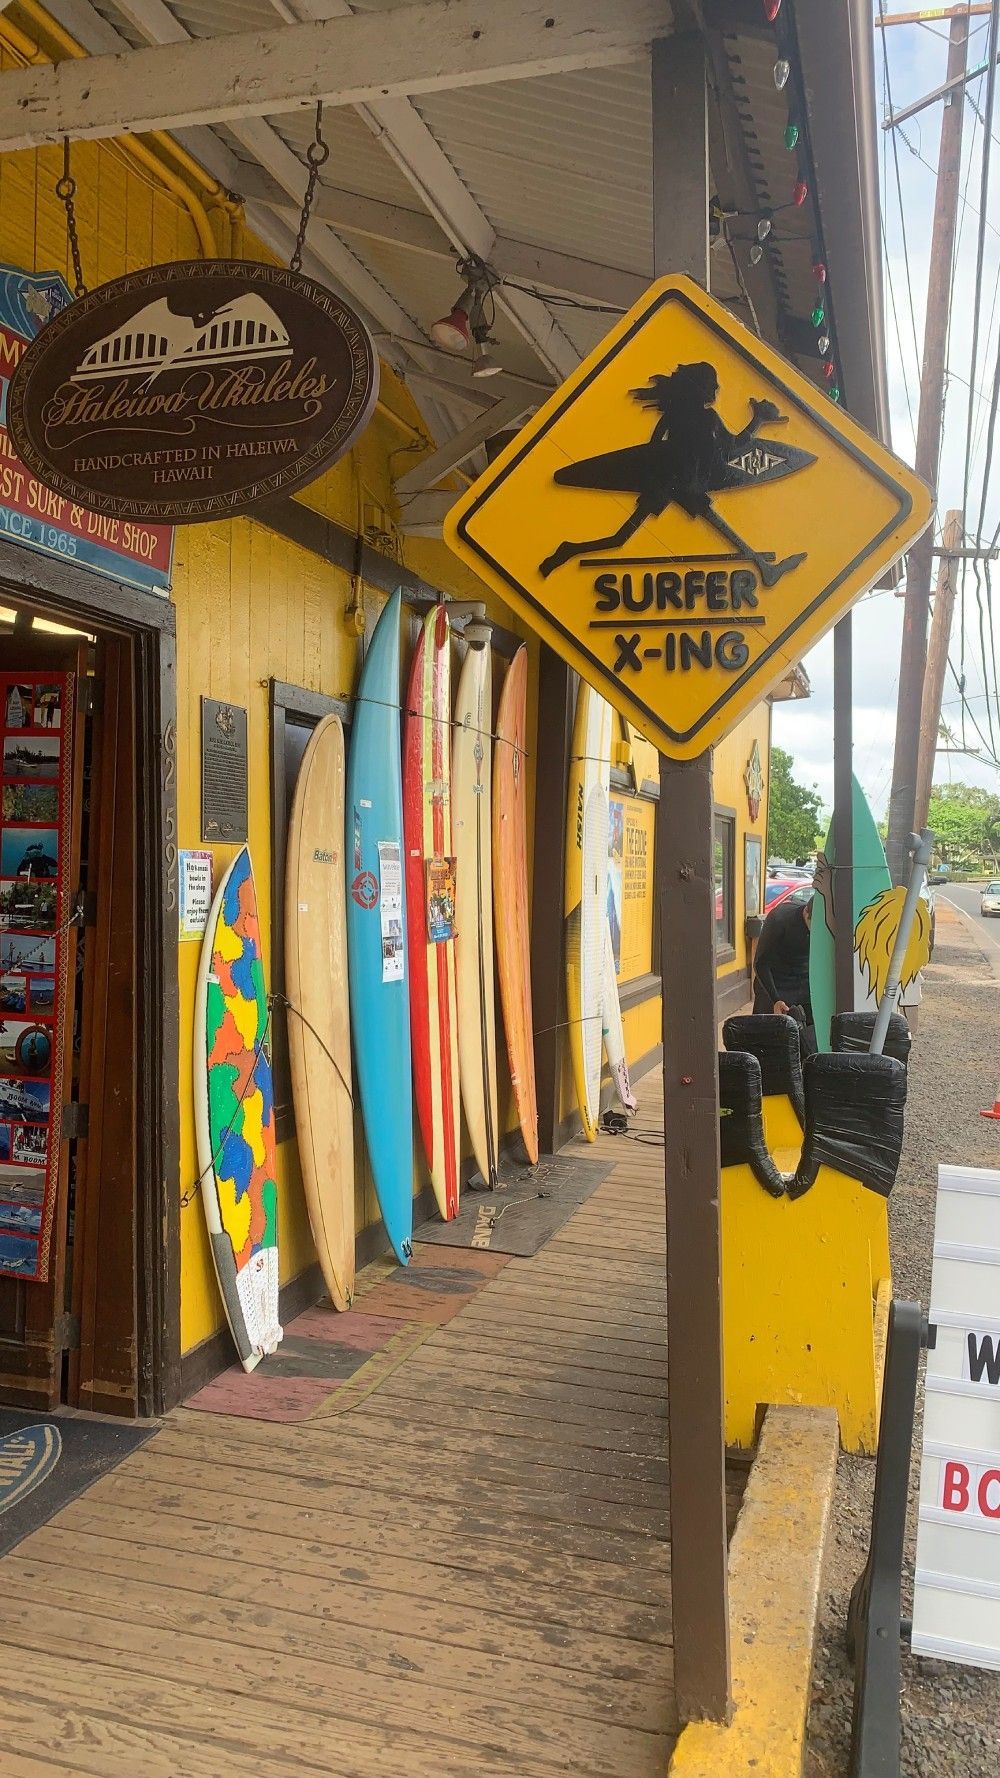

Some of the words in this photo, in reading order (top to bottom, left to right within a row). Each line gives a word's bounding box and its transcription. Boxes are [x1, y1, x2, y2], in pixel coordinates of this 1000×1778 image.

[42, 378, 194, 430] Haleiwa
[180, 357, 337, 412] Ukuleles
[74, 448, 197, 472] HANDCRAFTED
[202, 446, 221, 463] IN
[226, 438, 299, 458] HALEIWA
[154, 465, 213, 483] HAWAII
[39, 524, 77, 556] 1965
[87, 511, 119, 544] DIVE
[122, 522, 158, 560] SHOP
[594, 569, 759, 612] SURFER
[613, 630, 749, 673] X-ING
[187, 863, 194, 872] No
[189, 874, 201, 882] bowls
[196, 884, 206, 893] shop
[187, 907, 198, 916] enjoy
